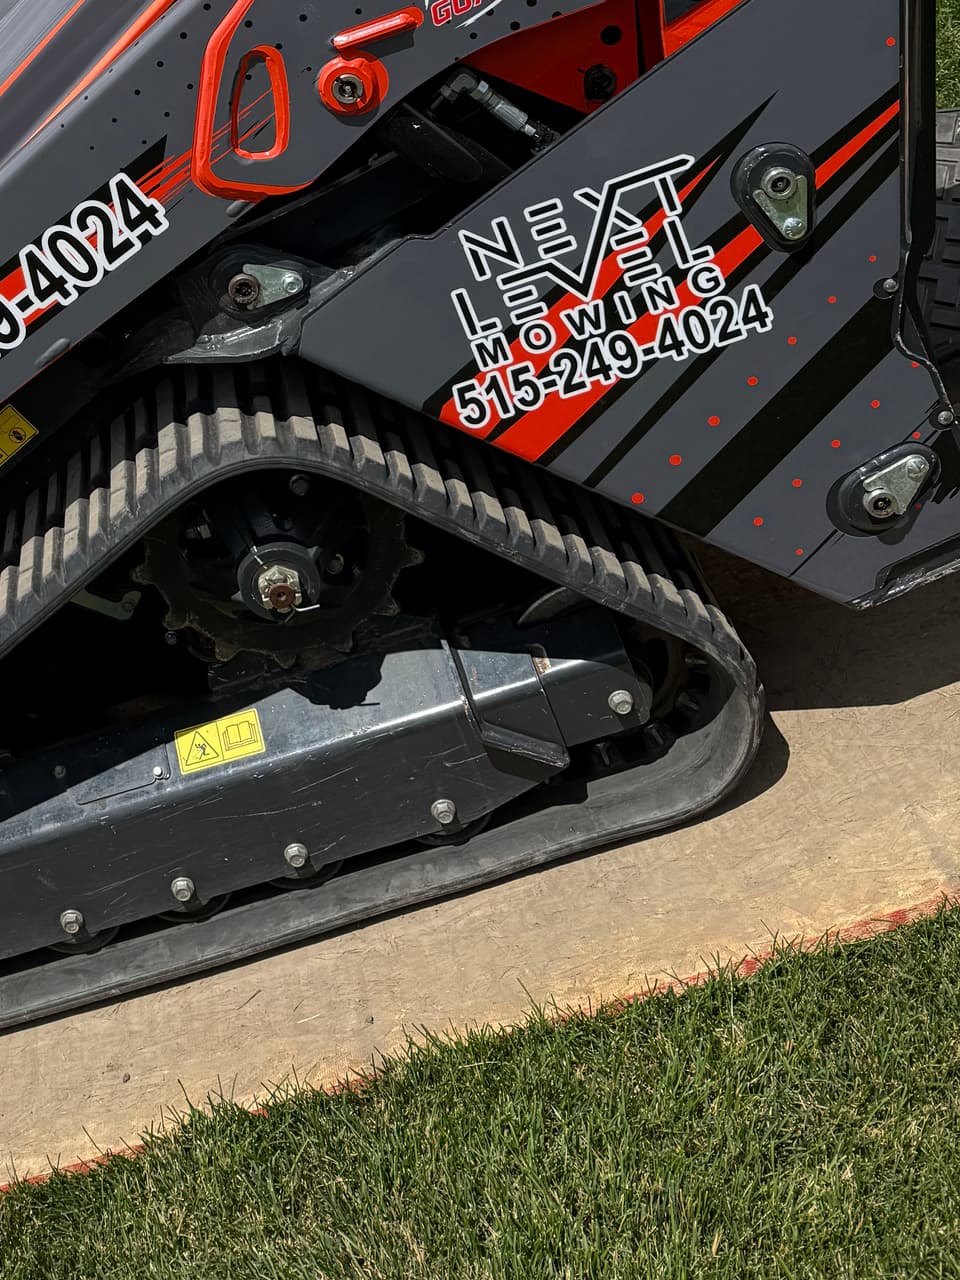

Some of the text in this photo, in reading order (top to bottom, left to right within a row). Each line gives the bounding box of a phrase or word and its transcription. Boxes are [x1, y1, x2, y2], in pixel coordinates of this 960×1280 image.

[451, 215, 714, 339] LEVEL
[458, 154, 695, 291] NEXT
[452, 284, 774, 428] 515-249-4024
[471, 262, 726, 371] MOWING
